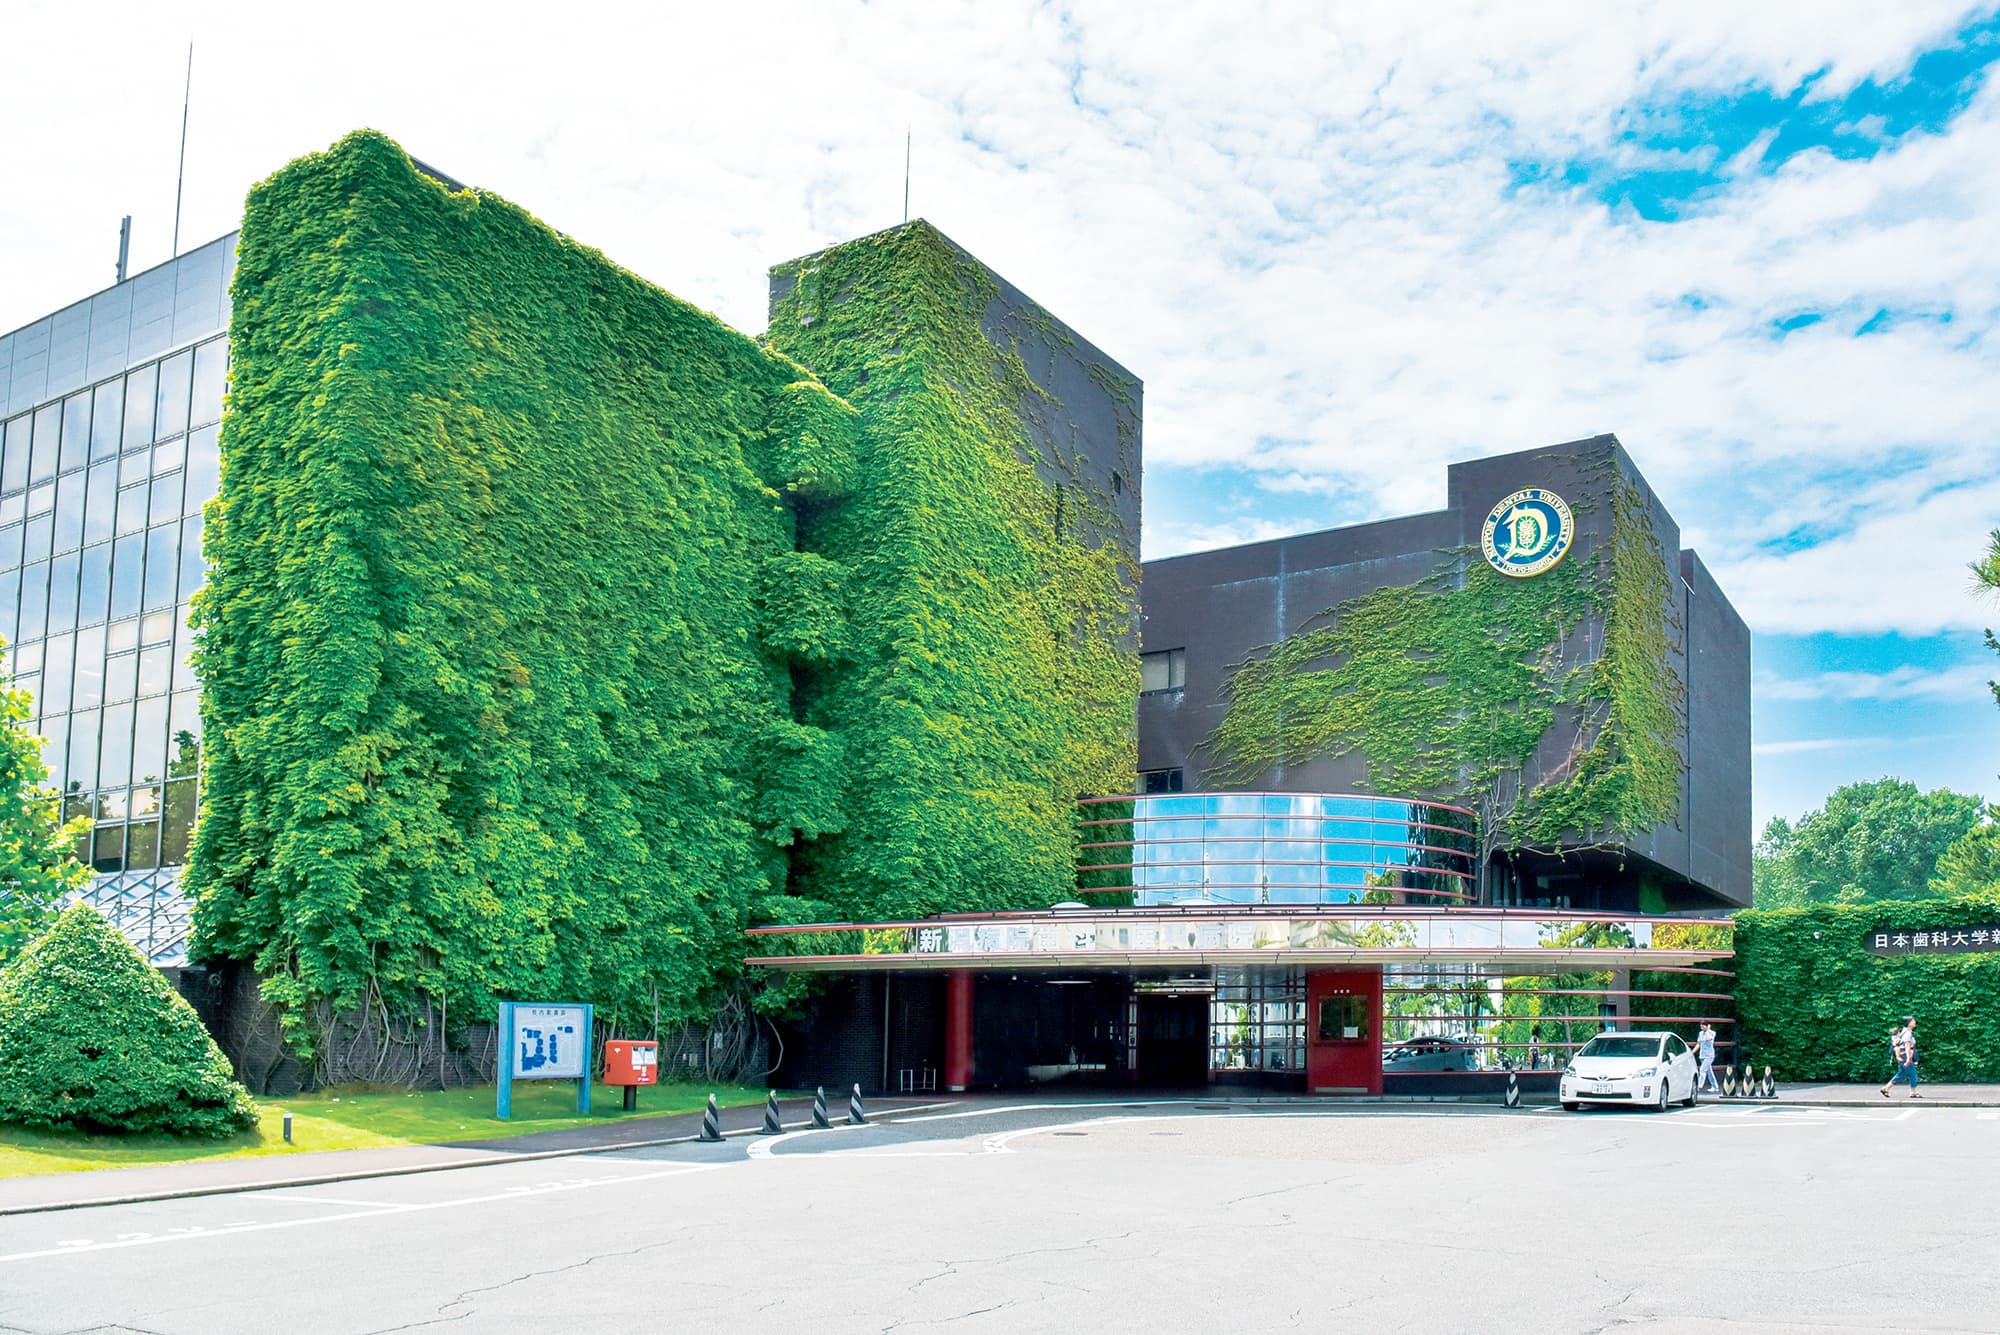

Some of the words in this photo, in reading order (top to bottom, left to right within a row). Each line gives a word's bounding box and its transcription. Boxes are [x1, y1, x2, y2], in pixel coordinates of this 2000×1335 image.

[1484, 520, 1496, 559] NIPPON
[1494, 491, 1534, 517] DENTAL
[1538, 491, 1570, 542] UNIVERSITY
